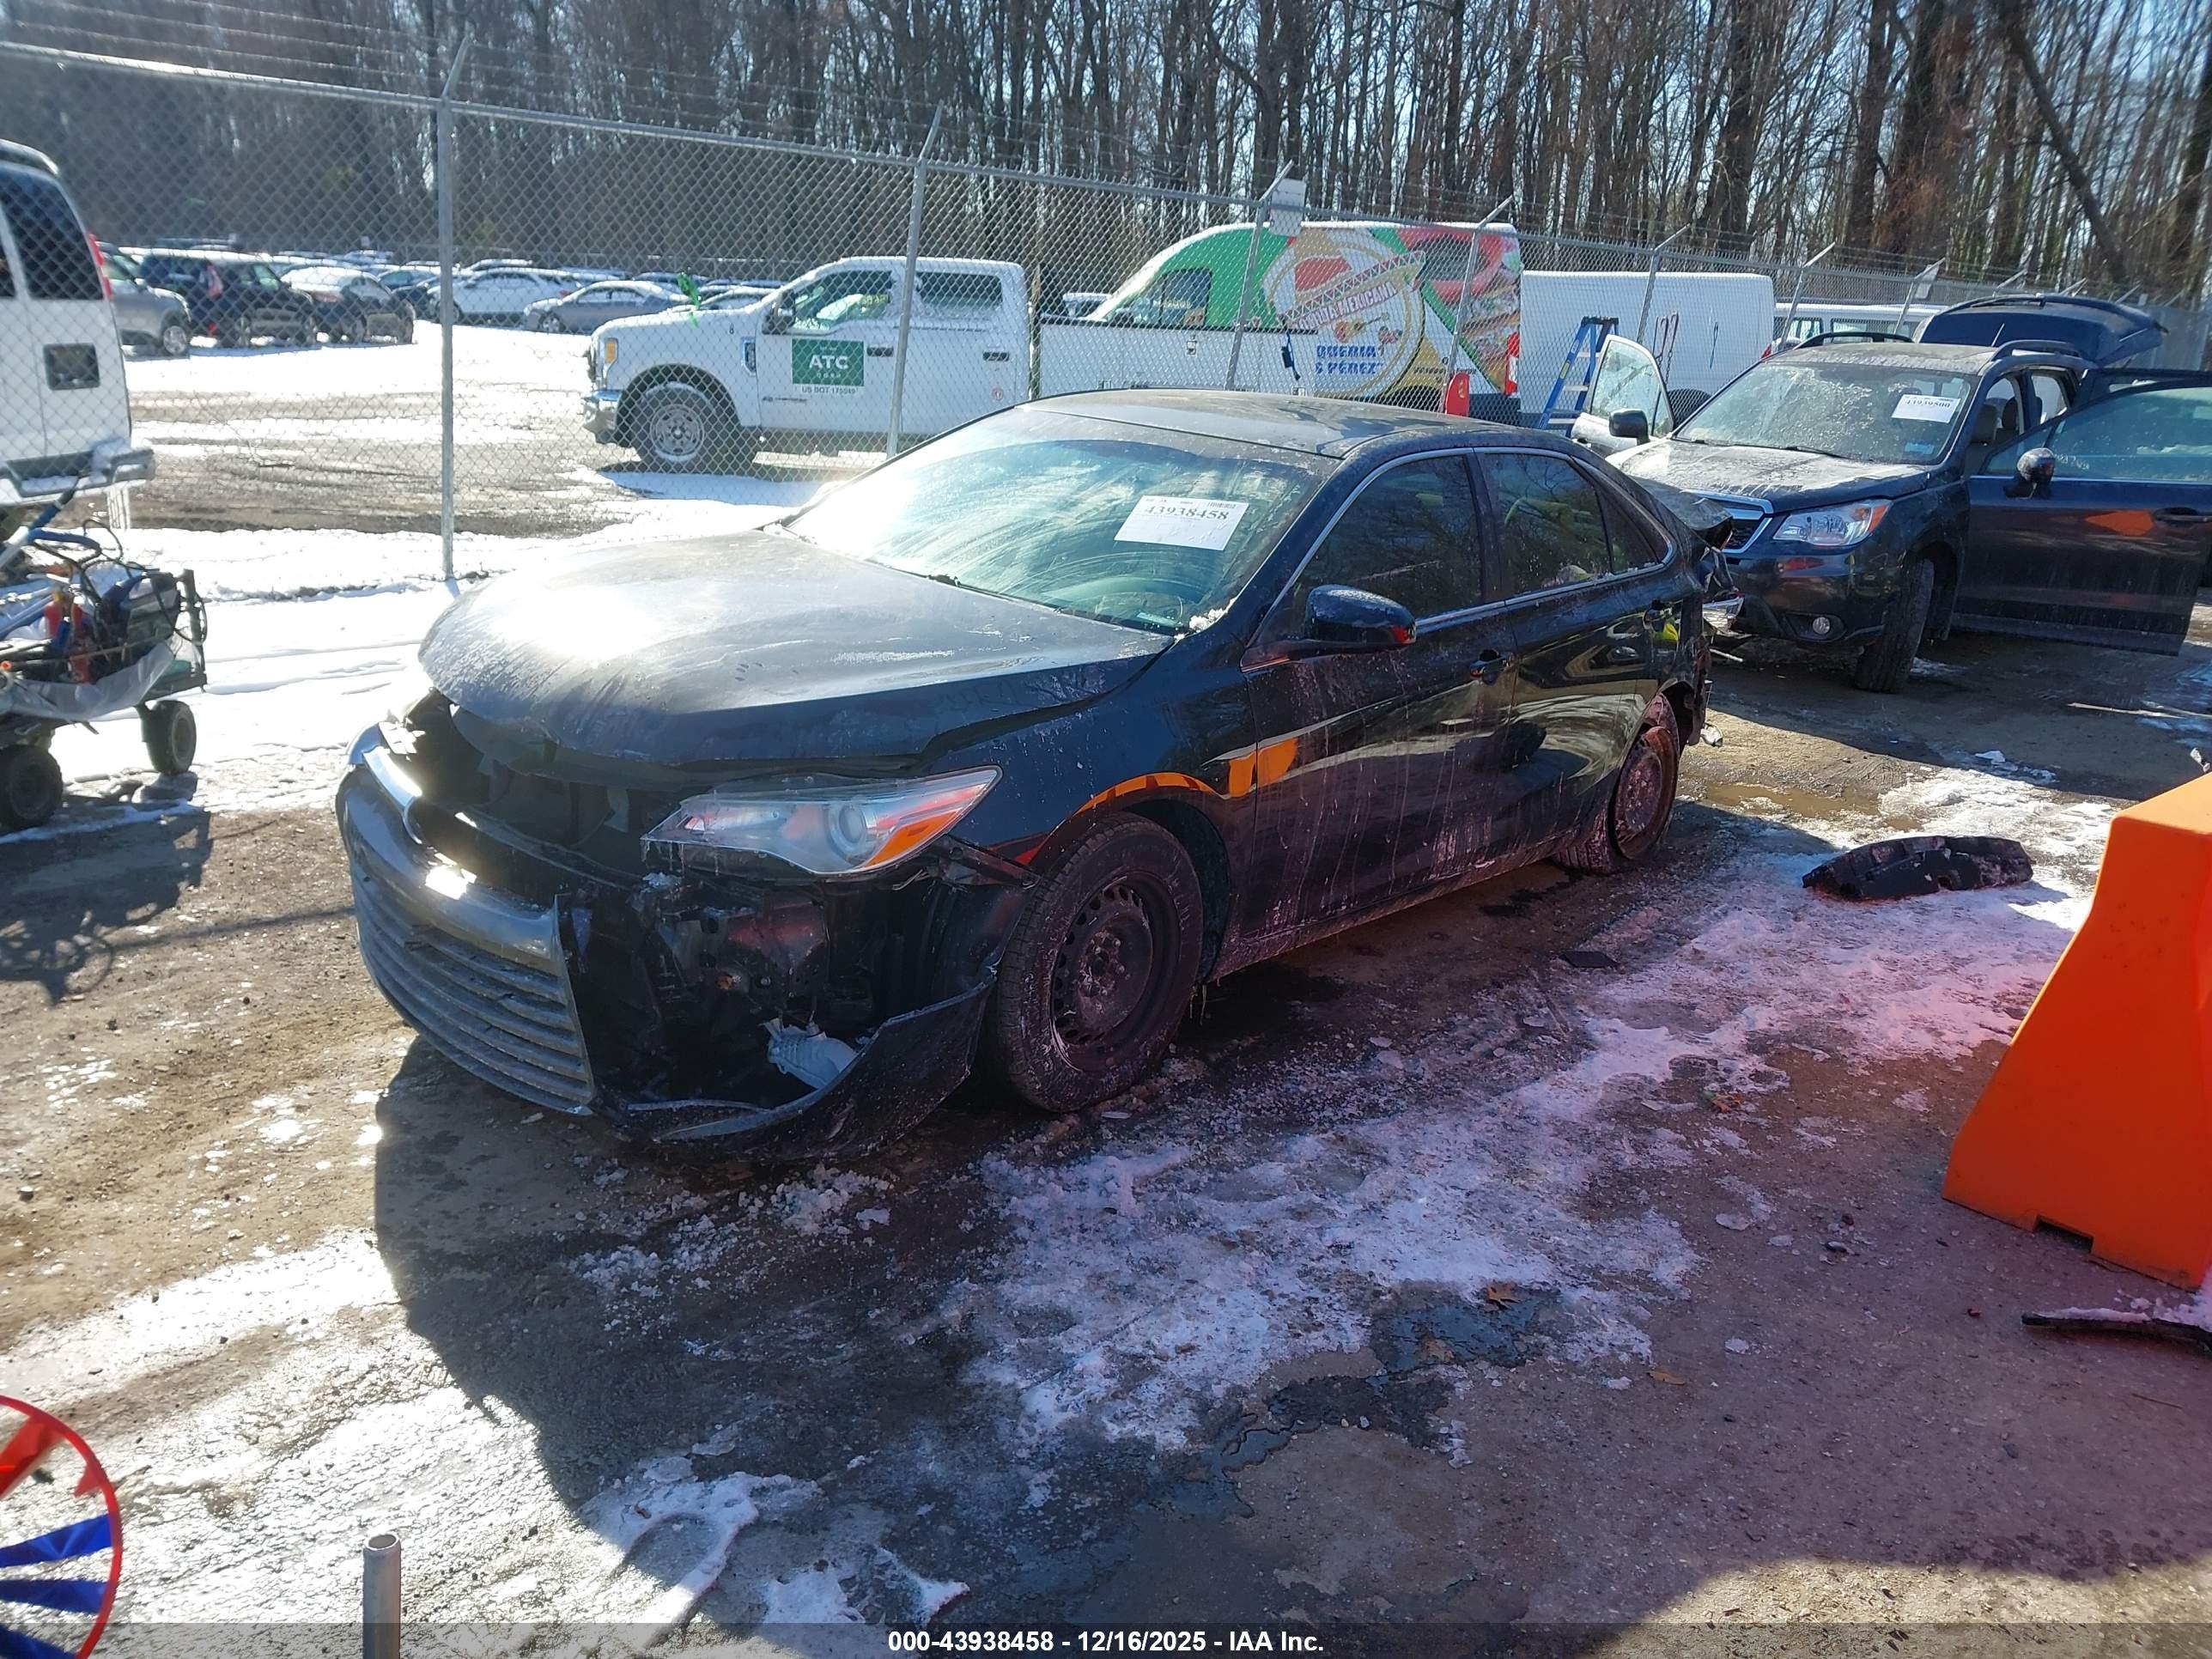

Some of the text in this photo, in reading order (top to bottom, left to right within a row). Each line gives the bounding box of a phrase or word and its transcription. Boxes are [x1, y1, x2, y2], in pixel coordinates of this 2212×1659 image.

[1335, 282, 1399, 317] MEXICANA
[809, 354, 849, 370] ATC
[814, 386, 831, 394] DOT
[1145, 506, 1230, 520] 43938458
